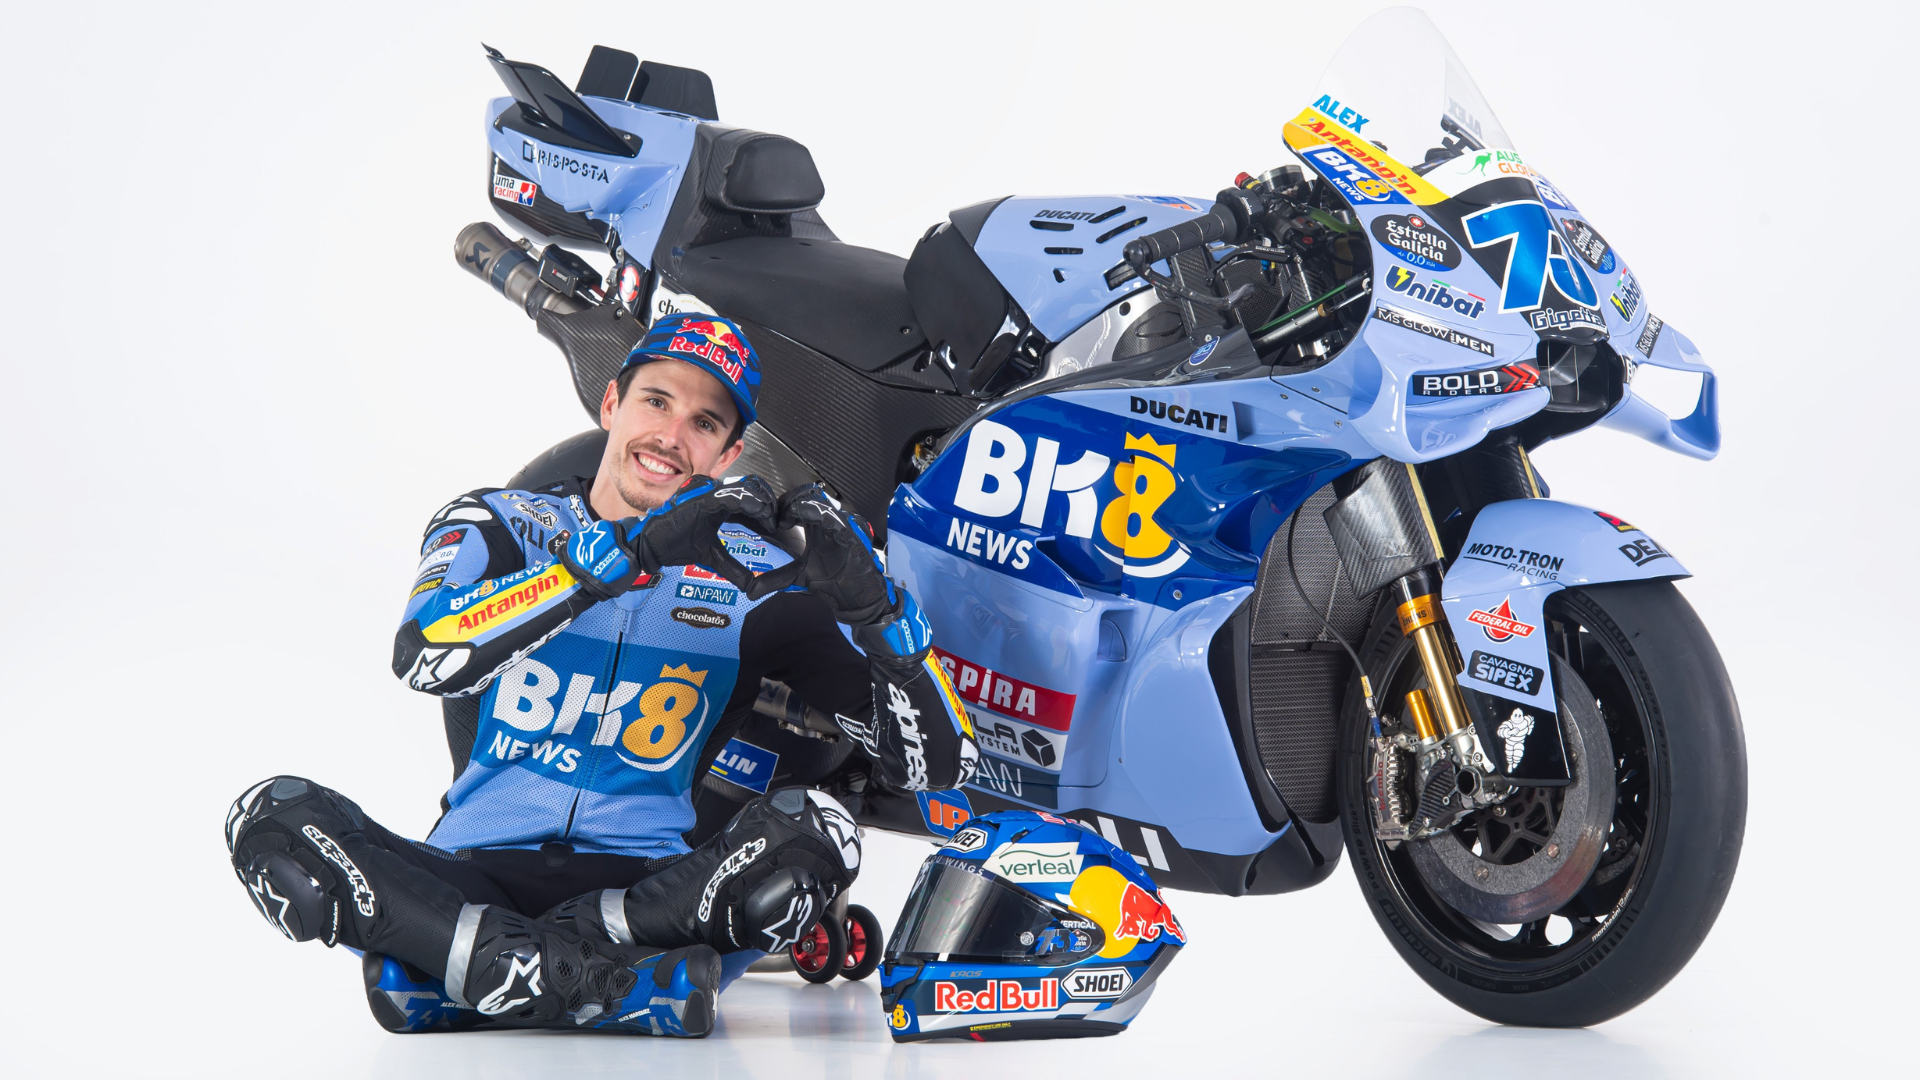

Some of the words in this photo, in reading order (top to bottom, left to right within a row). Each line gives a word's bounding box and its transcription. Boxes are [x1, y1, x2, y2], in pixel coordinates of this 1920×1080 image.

[1312, 94, 1370, 134] ALEX
[1300, 121, 1417, 195] Antangin
[496, 175, 514, 188] uma
[1313, 150, 1391, 199] BK8
[1332, 177, 1365, 201] NEWS
[495, 186, 519, 201] racing
[1034, 209, 1096, 221] DUCATI
[1386, 219, 1447, 251] Estrella
[1388, 232, 1444, 262] Galicia
[1384, 263, 1486, 320] Unibat
[1609, 273, 1643, 324] Unibat
[1378, 308, 1400, 324] MS
[1403, 316, 1450, 339] GLOW
[1455, 334, 1492, 354] MEN
[669, 337, 713, 359] Red
[710, 346, 743, 384] Bull
[1423, 370, 1499, 391] BOLD
[1423, 385, 1502, 396] RIDERS
[1130, 396, 1228, 433] DUCATI
[953, 419, 1178, 562] BK8
[520, 503, 553, 527] SHOEI
[946, 517, 1033, 570] NEWS
[1467, 542, 1564, 571] MOTO-TRON
[450, 579, 494, 610] BK8
[501, 560, 553, 586] NEWS
[1507, 562, 1559, 581] RACING
[457, 574, 559, 635] Antangin
[693, 585, 734, 604] NPAW
[1472, 612, 1511, 631] FEDERAL
[1512, 624, 1528, 635] OIL
[1474, 663, 1533, 692] SIPEX
[1478, 654, 1534, 678] CAVAGNA
[492, 657, 702, 762] BK8
[487, 730, 582, 773] NEWS
[974, 733, 1021, 756] YSTEM
[1377, 761, 1385, 812] brembo
[946, 857, 985, 876] WINGS
[1000, 858, 1077, 878] verleal
[1356, 839, 1380, 890] POWER
[1382, 901, 1439, 964] MICHELIN
[936, 981, 996, 1011] Red
[1001, 979, 1058, 1010] Bull
[1073, 974, 1123, 993] SHOEI
